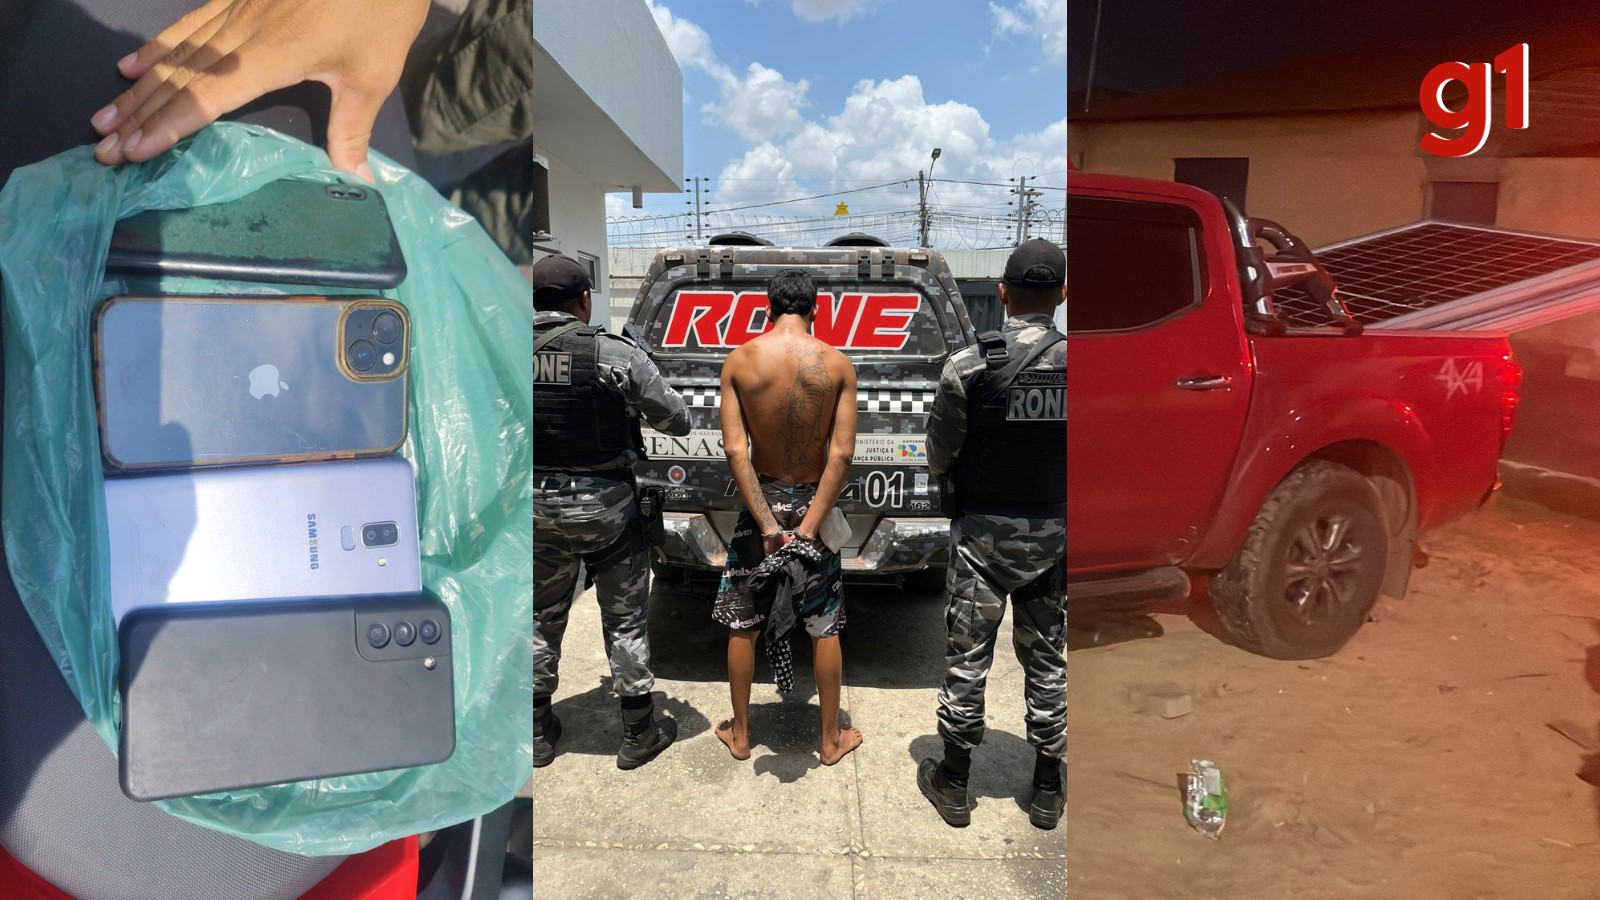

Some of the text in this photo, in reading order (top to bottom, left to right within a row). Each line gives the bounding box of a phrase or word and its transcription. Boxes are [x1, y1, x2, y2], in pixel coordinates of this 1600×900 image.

[869, 454, 894, 462] PÚBLICA
[865, 470, 904, 508] 01
[911, 501, 931, 510] 162
[307, 513, 319, 570] SAMSUNG
